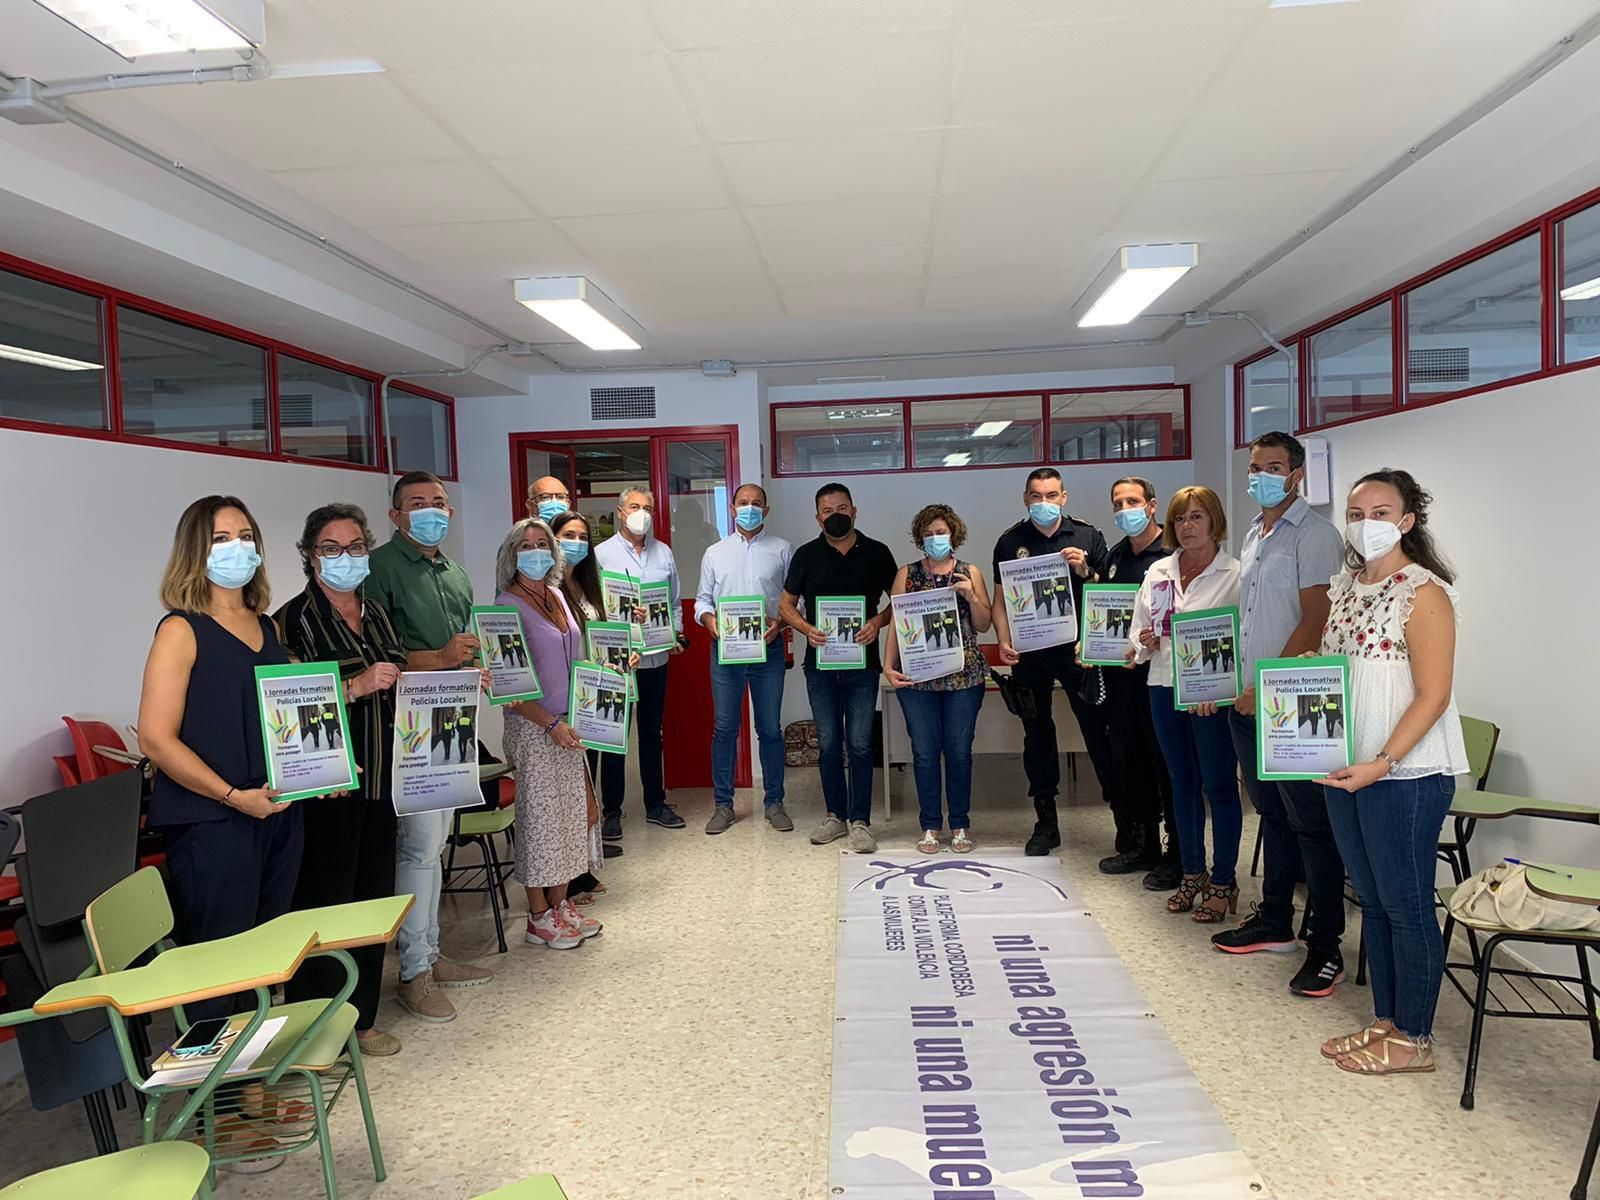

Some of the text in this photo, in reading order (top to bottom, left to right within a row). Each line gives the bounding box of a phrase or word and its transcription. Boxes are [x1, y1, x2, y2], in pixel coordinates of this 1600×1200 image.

[1006, 566, 1032, 576] Jornadas
[1034, 562, 1066, 572] formativas
[1037, 571, 1058, 579] Locales
[269, 687, 298, 696] Jornadas
[300, 685, 334, 693] formativas
[404, 684, 437, 694] Jornadas
[438, 684, 477, 692] formativas
[303, 695, 326, 703] Locales
[440, 696, 466, 704] Locales
[882, 901, 901, 914] LAS
[884, 915, 906, 951] MUJERES
[908, 894, 940, 980] CONTRA LA VIOLENCIA
[934, 894, 976, 998] PLATAFORMA CORDOBESA
[992, 934, 1050, 952] ni
[1000, 958, 1056, 998] una
[910, 1006, 974, 1028] ni
[913, 1037, 974, 1092] una
[1008, 1006, 1132, 1145] agresión
